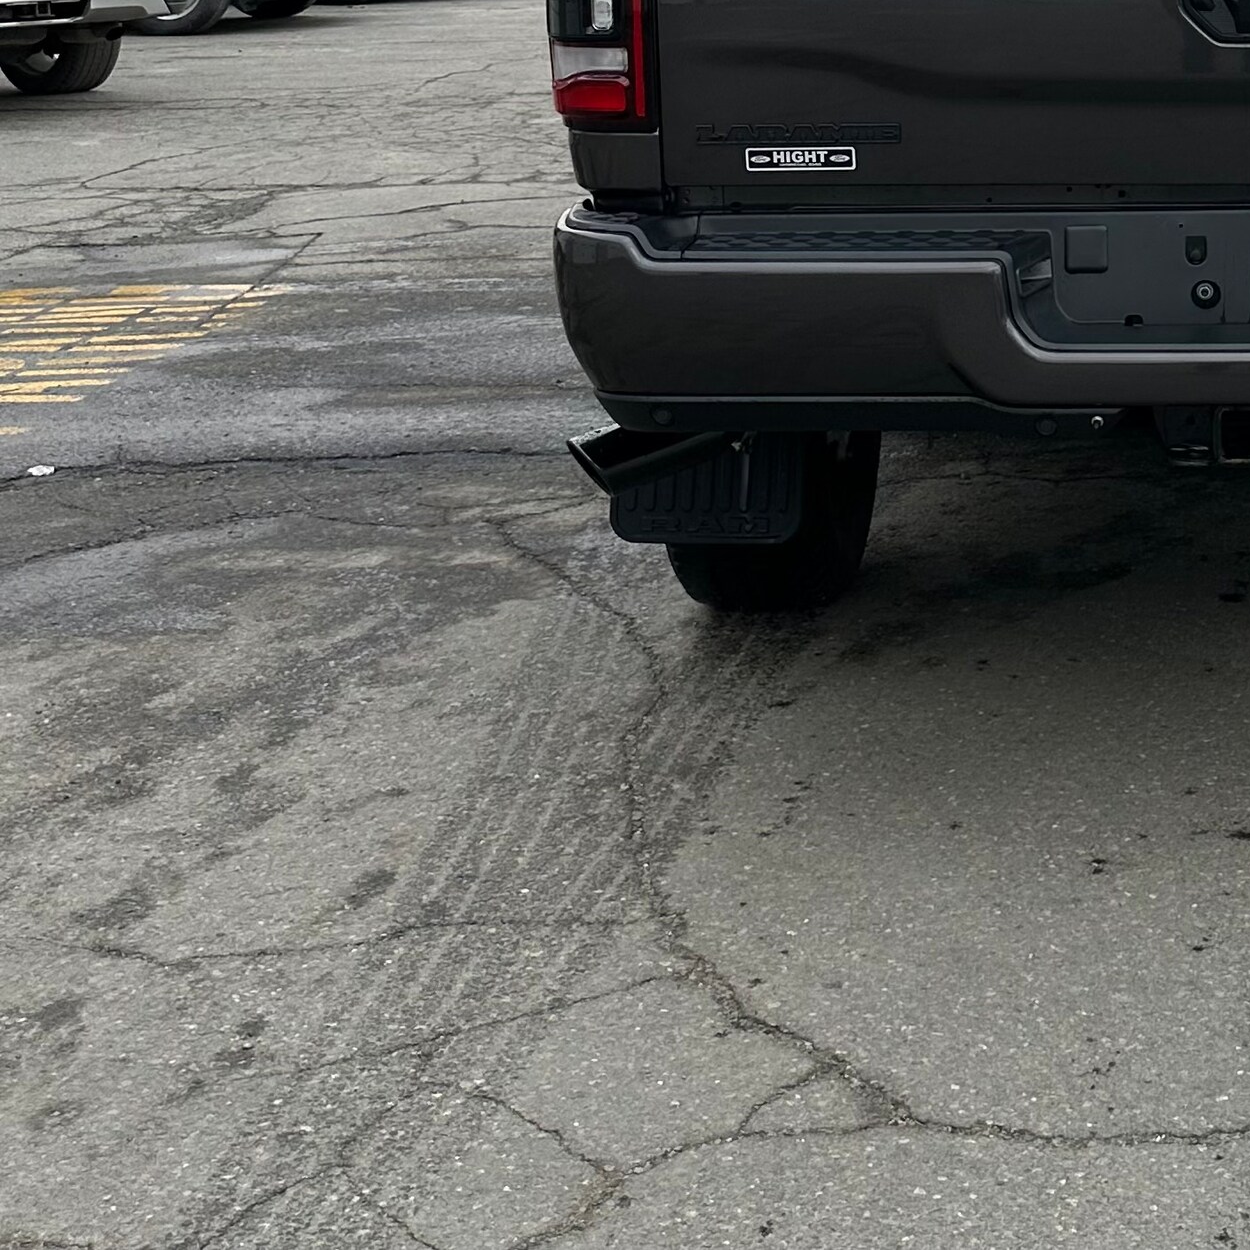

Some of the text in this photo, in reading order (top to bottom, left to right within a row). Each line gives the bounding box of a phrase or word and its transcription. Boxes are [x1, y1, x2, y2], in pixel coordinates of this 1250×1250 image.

[695, 123, 902, 145] LARAMIE
[772, 151, 828, 163] HIGHT
[640, 516, 769, 534] RAM
